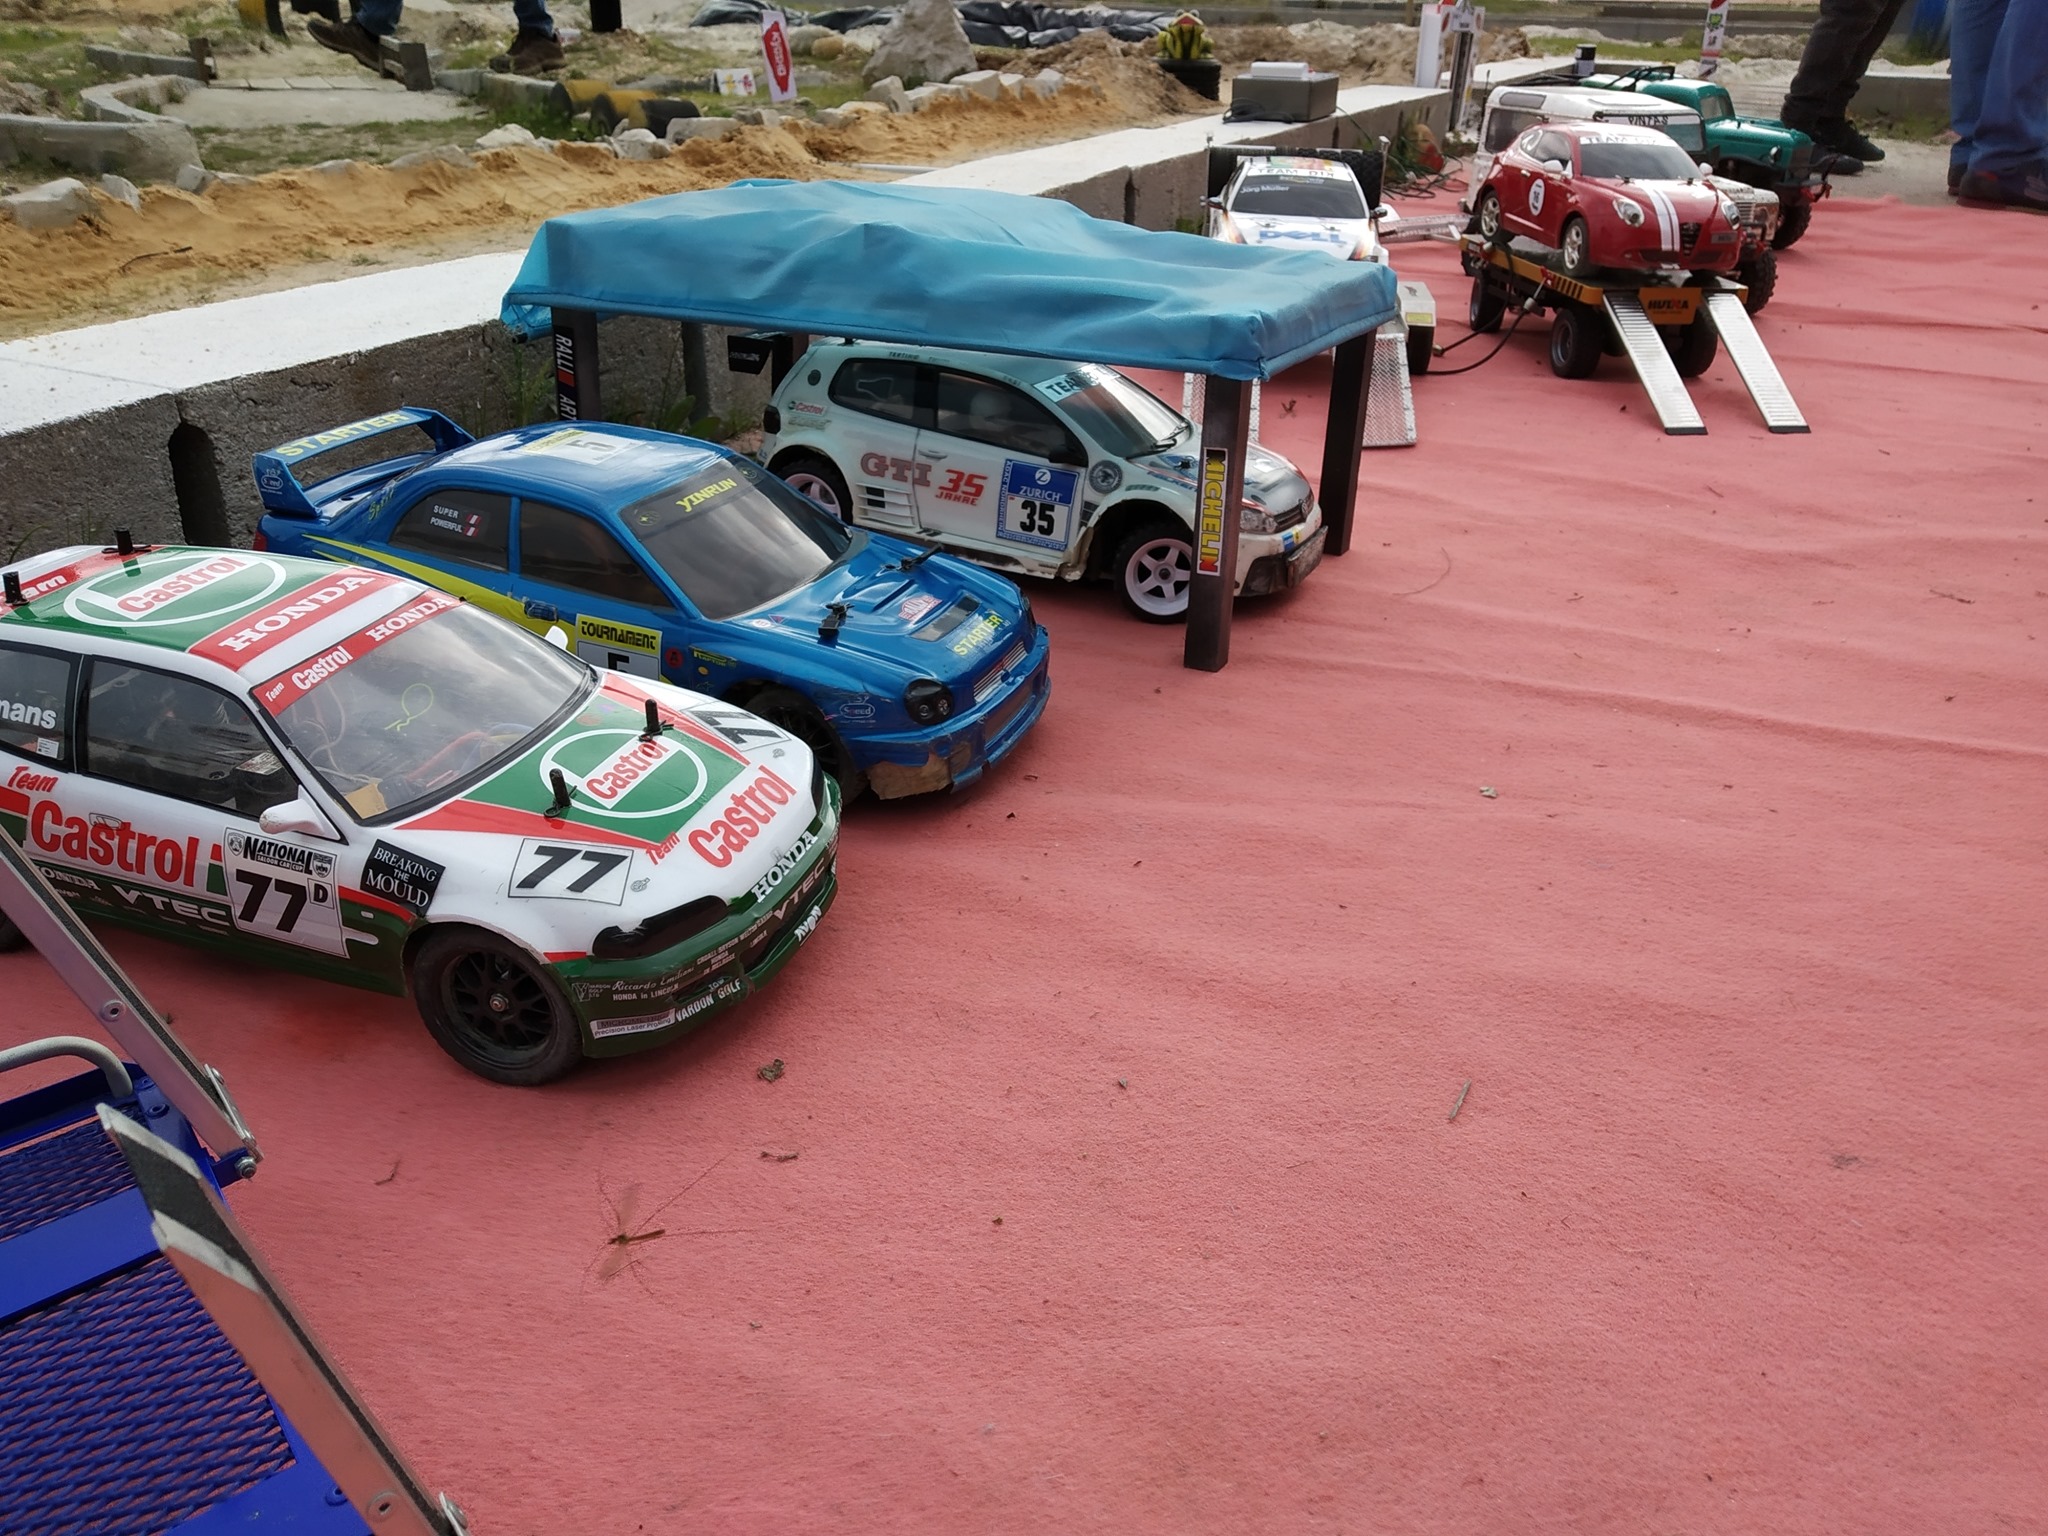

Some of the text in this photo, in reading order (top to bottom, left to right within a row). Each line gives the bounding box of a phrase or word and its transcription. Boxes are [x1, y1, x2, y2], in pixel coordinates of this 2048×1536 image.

[1261, 184, 1290, 192] Müller
[1259, 230, 1347, 244] DELL
[555, 334, 575, 375] RALLI
[794, 402, 824, 414] Castrol
[276, 412, 410, 457] STARTER
[860, 452, 989, 498] GTI 35
[1002, 461, 1012, 485] ADAC
[433, 504, 459, 519] SUPER
[676, 477, 738, 513] YINRUN
[935, 491, 979, 506] JAHRE
[1019, 485, 1061, 503] ZURICH
[1199, 449, 1226, 573] MICHELIN
[430, 516, 463, 533] POWERFUL
[1019, 499, 1055, 536] 35
[117, 556, 248, 614] Castrol
[218, 574, 375, 653] HONDA
[264, 595, 457, 703] Team Castrol HONDA
[581, 620, 657, 651] TOURNAMENT
[953, 613, 1004, 656] STARTER
[689, 710, 783, 745] 77
[7, 765, 59, 793] Team
[586, 739, 670, 800] Castrol
[646, 764, 798, 868] Team Castrol
[31, 799, 200, 887] Castrol
[243, 836, 313, 875] NATIONAL
[256, 854, 304, 872] SALOON CAR CUP
[373, 846, 438, 882] BREAKING
[393, 869, 410, 882] THE
[515, 845, 630, 893] 77
[751, 831, 819, 904] HONDA
[41, 867, 231, 926] ONDA VTEC
[235, 869, 308, 933] 77
[313, 883, 329, 904] D
[365, 869, 429, 907] MOULD
[772, 858, 826, 921] VTEC
[794, 905, 823, 942] AVON
[612, 980, 657, 992] Riccardo
[612, 992, 638, 1001] HONDA
[640, 992, 648, 1000] in
[675, 995, 715, 1023] VARDON
[717, 978, 742, 1000] GOLF
[594, 1026, 626, 1037] Precision
[626, 1022, 646, 1032] Laser
